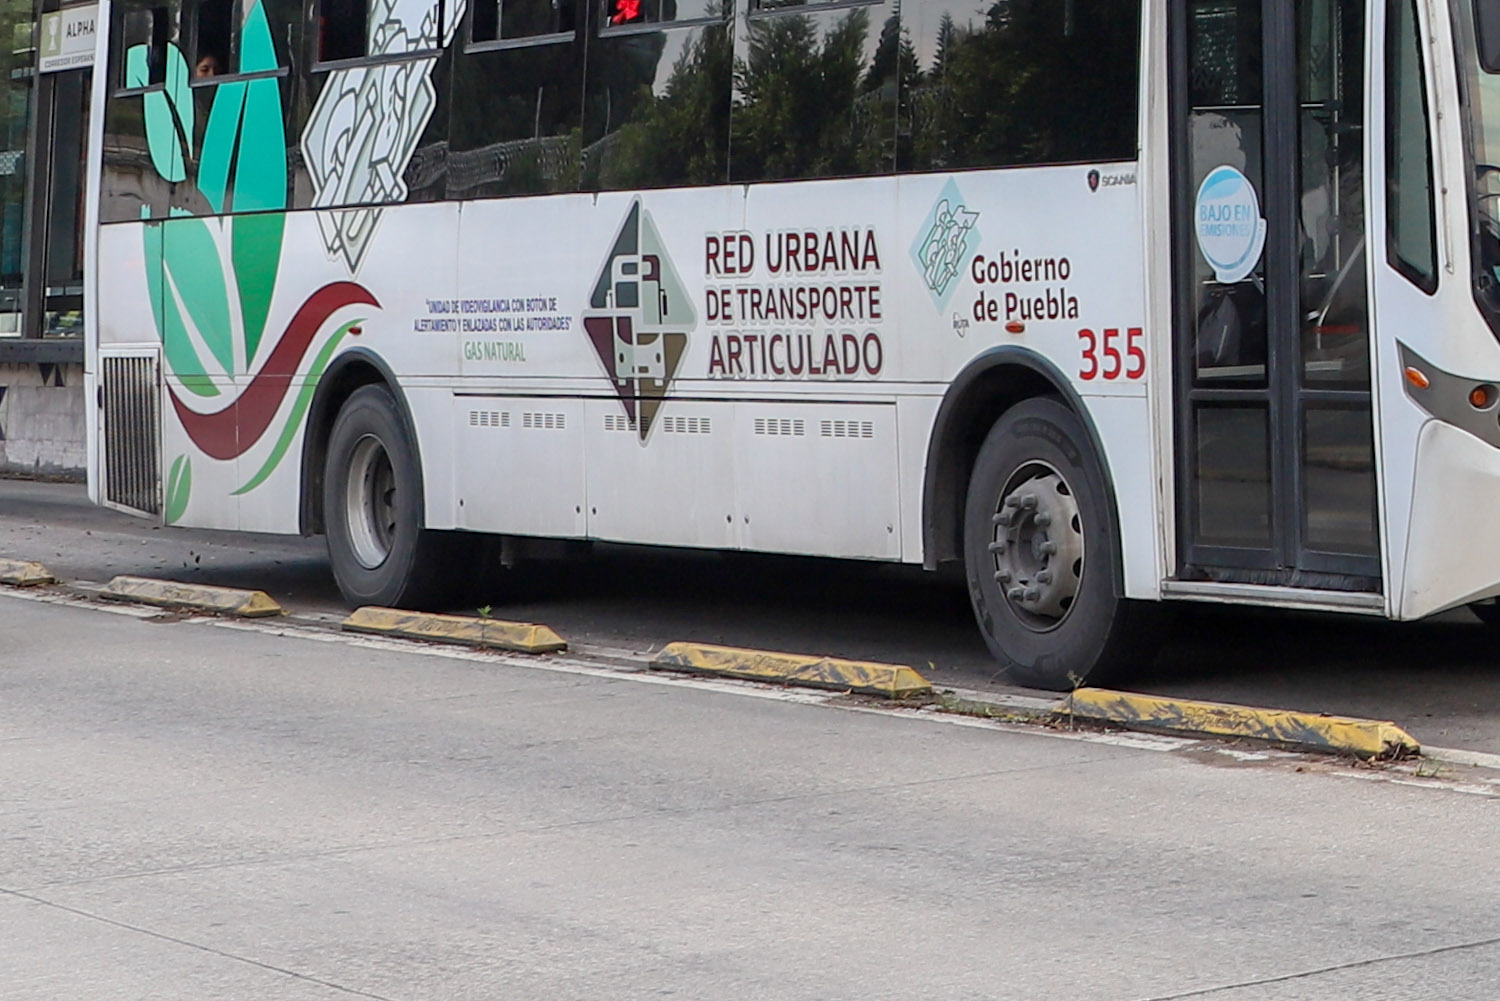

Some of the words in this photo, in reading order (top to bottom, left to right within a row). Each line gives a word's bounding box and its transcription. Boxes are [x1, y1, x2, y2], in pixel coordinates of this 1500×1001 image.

[67, 19, 95, 38] ALPHA
[1200, 204, 1231, 221] BAJO
[1234, 204, 1250, 221] EN
[1200, 224, 1249, 236] EMISIONES
[706, 235, 754, 274] RED
[766, 230, 881, 273] URBANA
[972, 249, 1071, 285] Gobierno
[451, 300, 459, 313] DE
[460, 299, 510, 313] VIDEOVIGILANCIA
[511, 299, 525, 312] CON
[549, 298, 557, 311] DE
[706, 288, 732, 321] DE
[737, 286, 882, 320] TRANSPORTE
[973, 290, 998, 322] de
[1005, 287, 1079, 321] Puebla
[499, 318, 511, 331] CON
[513, 318, 525, 331] LAS
[464, 341, 483, 361] GAS
[484, 342, 526, 362] NATURAL
[709, 332, 883, 375] ARTICULADO
[1077, 327, 1146, 381] 355
